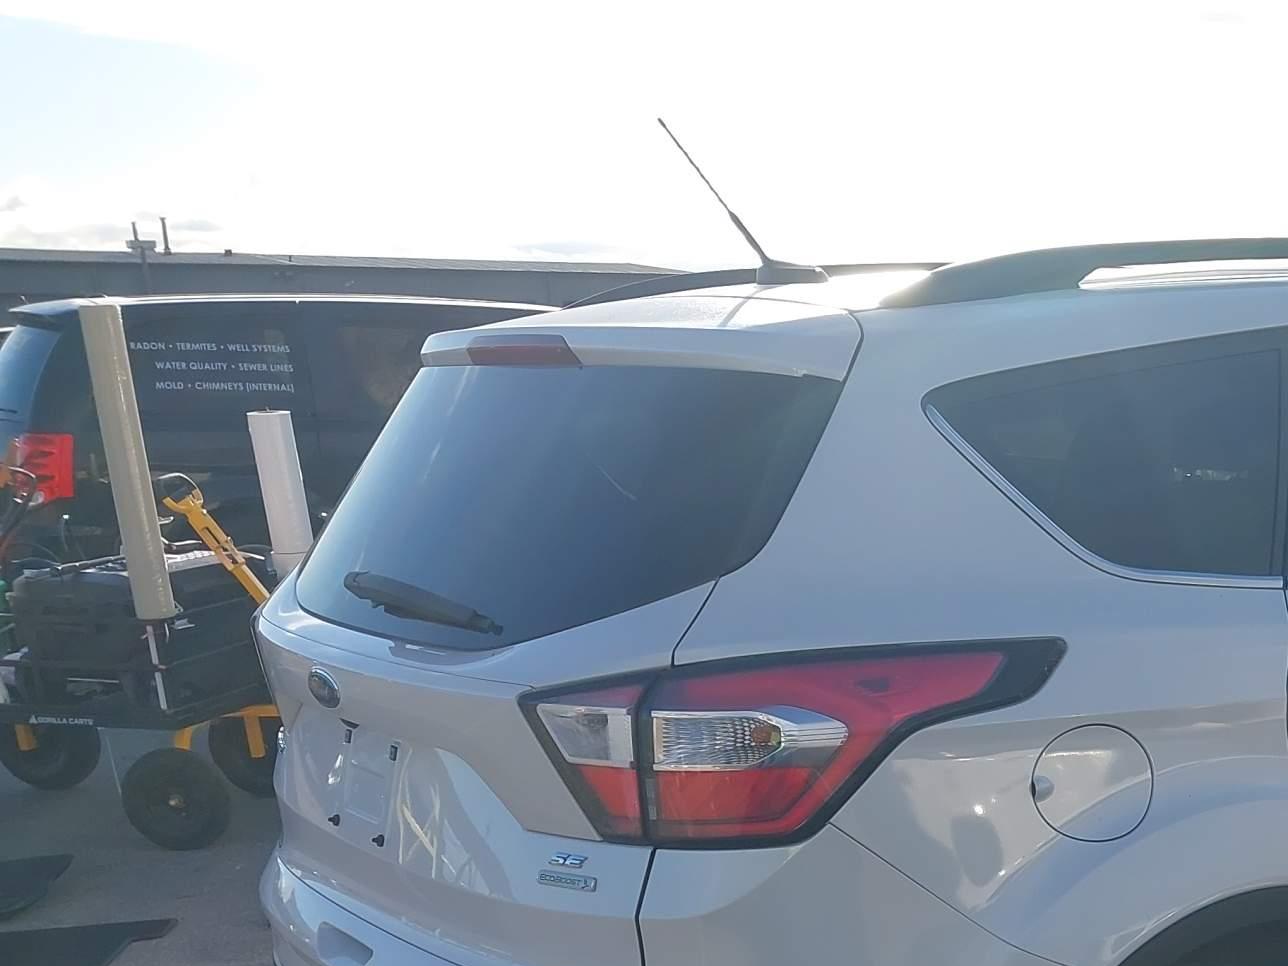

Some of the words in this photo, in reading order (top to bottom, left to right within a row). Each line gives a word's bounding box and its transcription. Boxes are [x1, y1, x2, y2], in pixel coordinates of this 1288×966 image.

[129, 341, 166, 350] RADON
[175, 342, 217, 351] TERMITES
[226, 343, 250, 352] WELL
[251, 344, 290, 353] SYSTEMS
[155, 361, 190, 370] WATER
[190, 361, 228, 371] QUALITY
[238, 362, 268, 372] SEWER
[270, 363, 294, 373] LINES
[155, 381, 184, 390] MOLD
[195, 382, 244, 391] CHIMNEYS
[548, 852, 588, 868] SE
